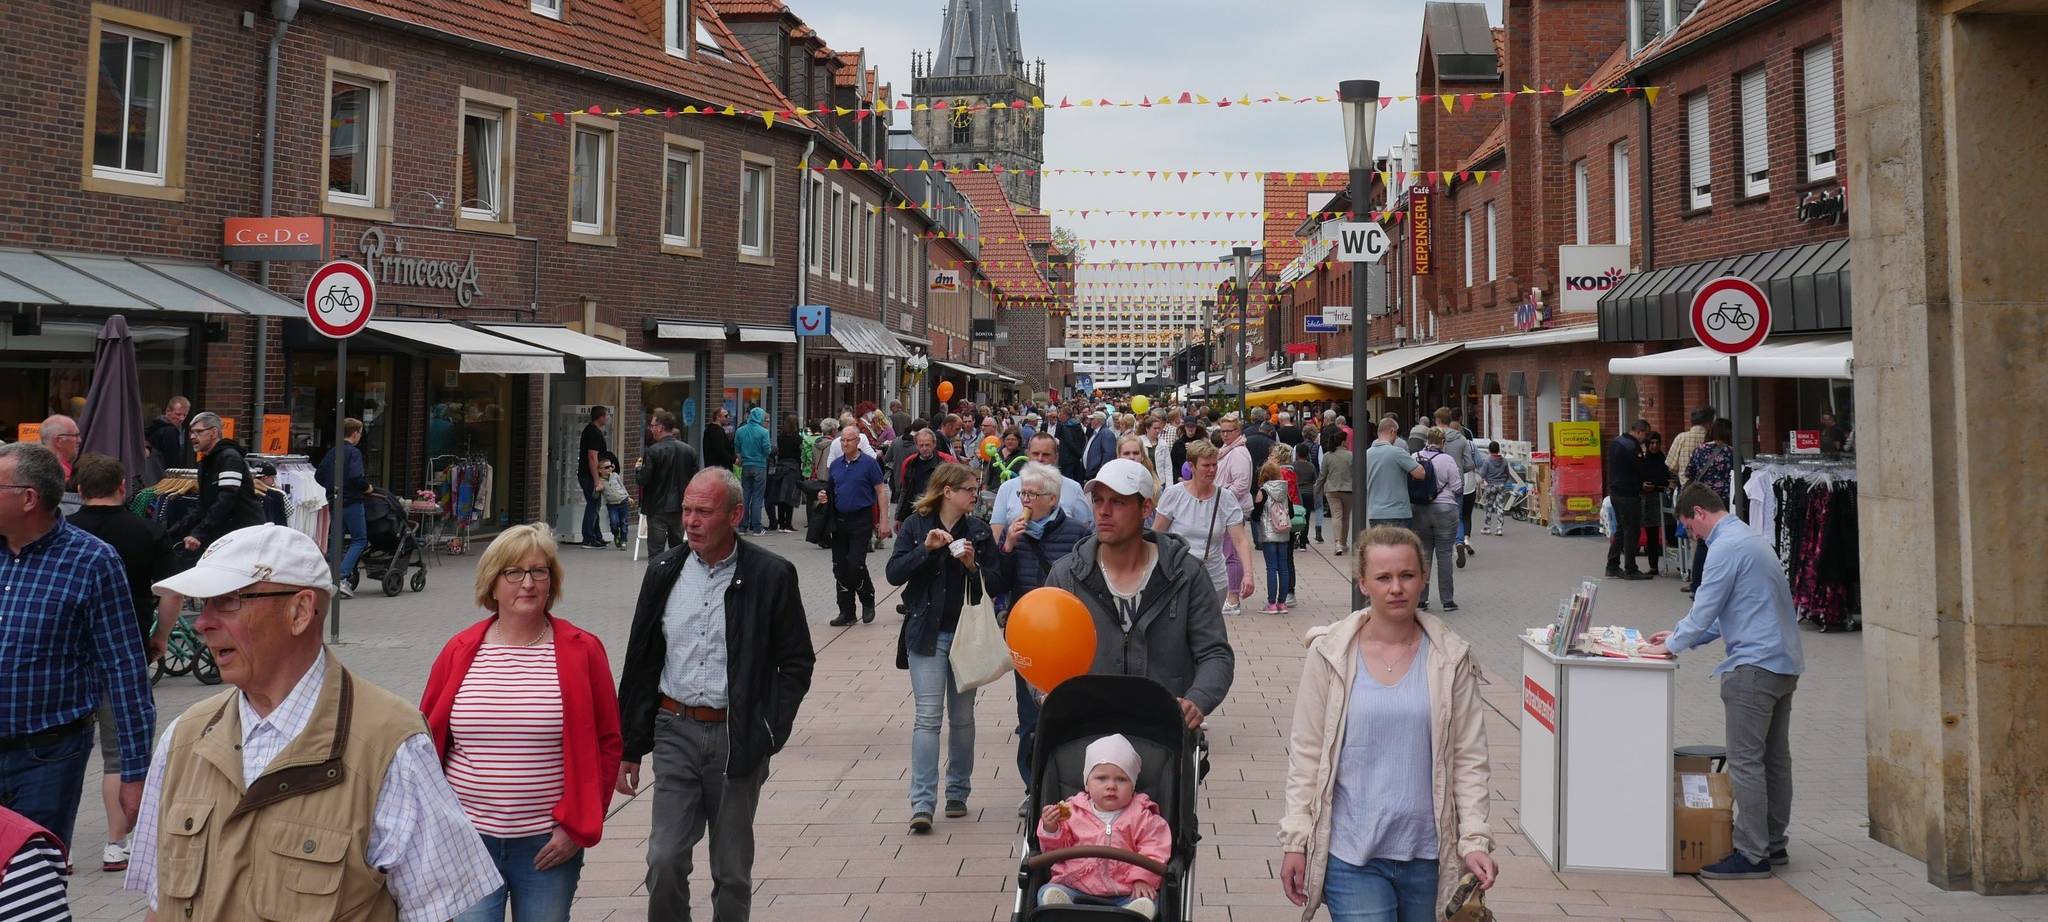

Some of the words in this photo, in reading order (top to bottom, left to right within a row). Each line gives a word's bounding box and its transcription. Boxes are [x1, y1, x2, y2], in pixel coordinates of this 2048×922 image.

[1413, 186, 1429, 194] Café
[236, 228, 310, 243] CeDe
[1341, 229, 1381, 255] WC
[1415, 196, 1429, 274] KIEPENKERL
[935, 272, 954, 284] dm
